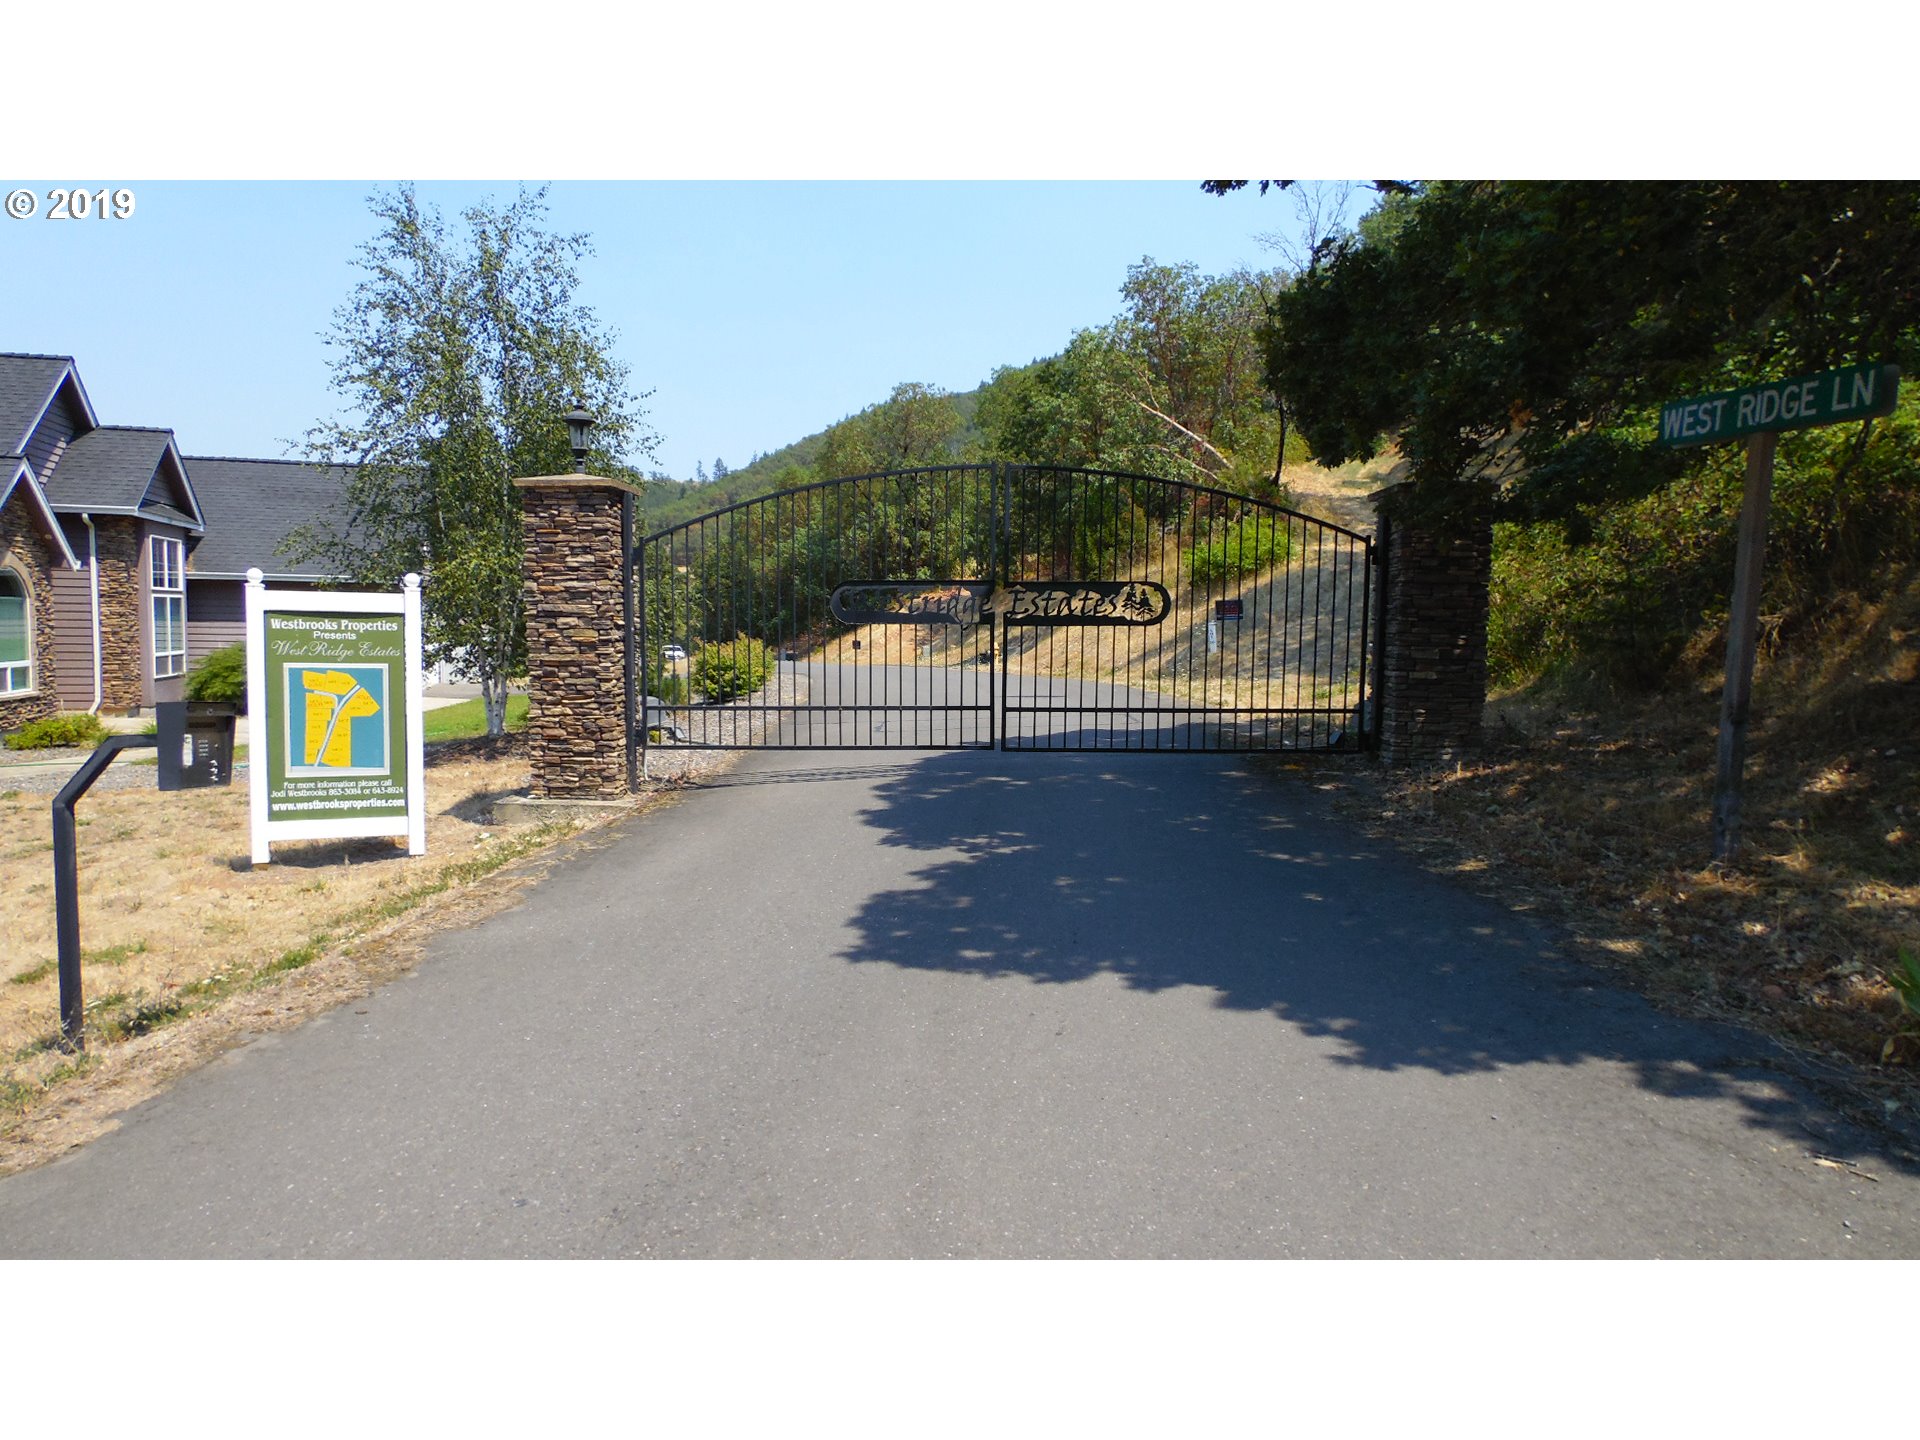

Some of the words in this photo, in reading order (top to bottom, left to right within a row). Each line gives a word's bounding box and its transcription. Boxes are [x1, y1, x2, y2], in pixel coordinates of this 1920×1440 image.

[1663, 398, 1728, 440] WEST
[1736, 379, 1820, 429] RIDGE
[1831, 368, 1876, 412] LN
[1008, 584, 1119, 619] Estates
[270, 618, 338, 630] Westbrooks
[340, 619, 398, 633] Properties
[313, 631, 357, 640] Presents
[271, 639, 309, 657] West
[308, 640, 355, 662] Ridge
[358, 641, 401, 657] Estates
[283, 781, 296, 789] For
[317, 780, 356, 788] information
[358, 780, 379, 789] please
[270, 790, 286, 798] Jodi
[287, 789, 328, 797] Westbrooks
[271, 798, 405, 811] www.westbrooksproperties.com
